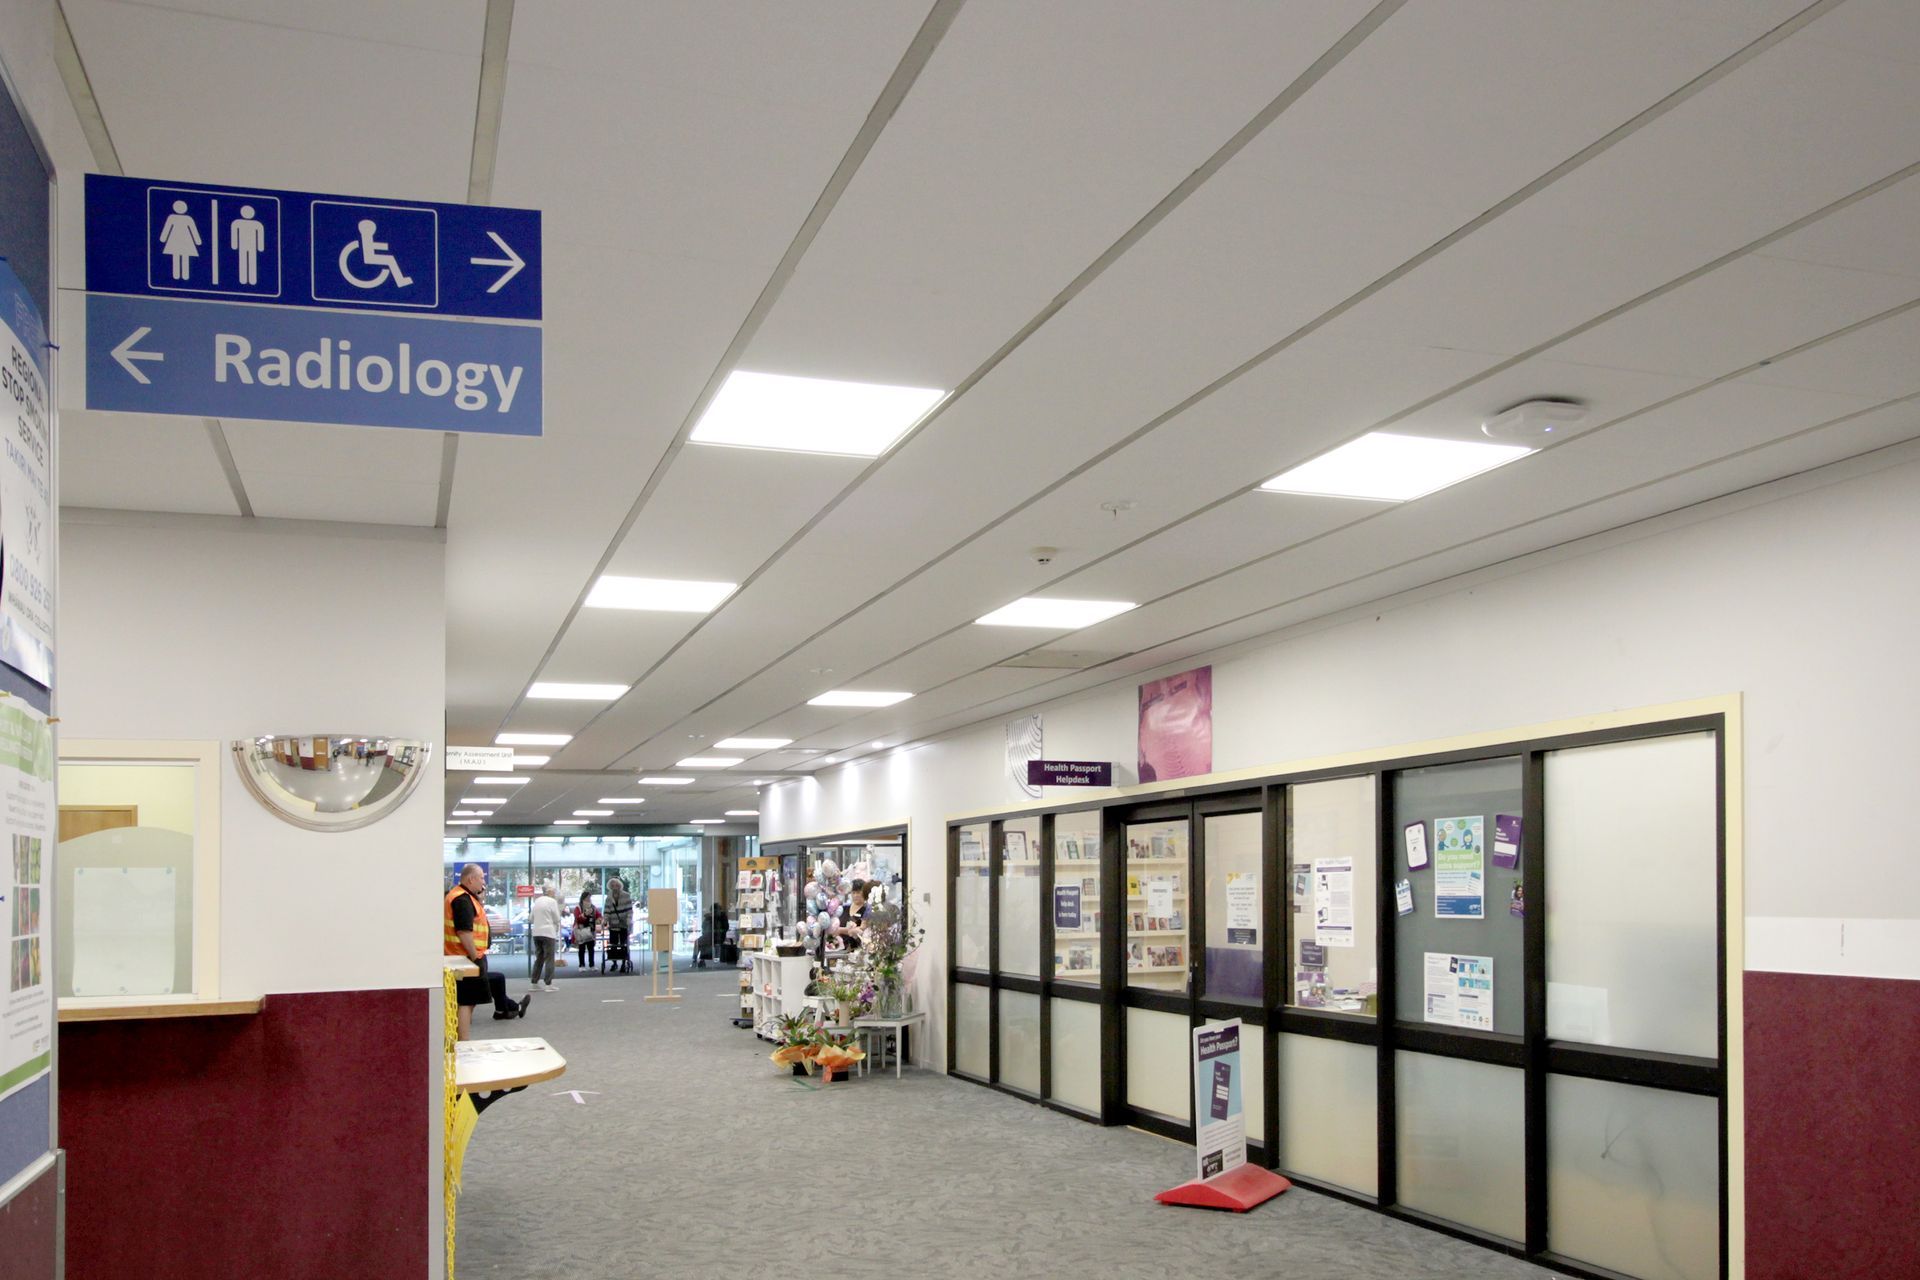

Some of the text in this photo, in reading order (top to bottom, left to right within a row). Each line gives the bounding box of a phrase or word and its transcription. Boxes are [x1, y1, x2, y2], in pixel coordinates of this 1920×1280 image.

[2, 366, 25, 406] STOP
[214, 333, 523, 413] Radiology
[18, 416, 44, 467] SERVICE
[1044, 763, 1101, 774] Health Passport
[1056, 775, 1090, 784] Helpdesk
[1200, 1042, 1216, 1055] Health
